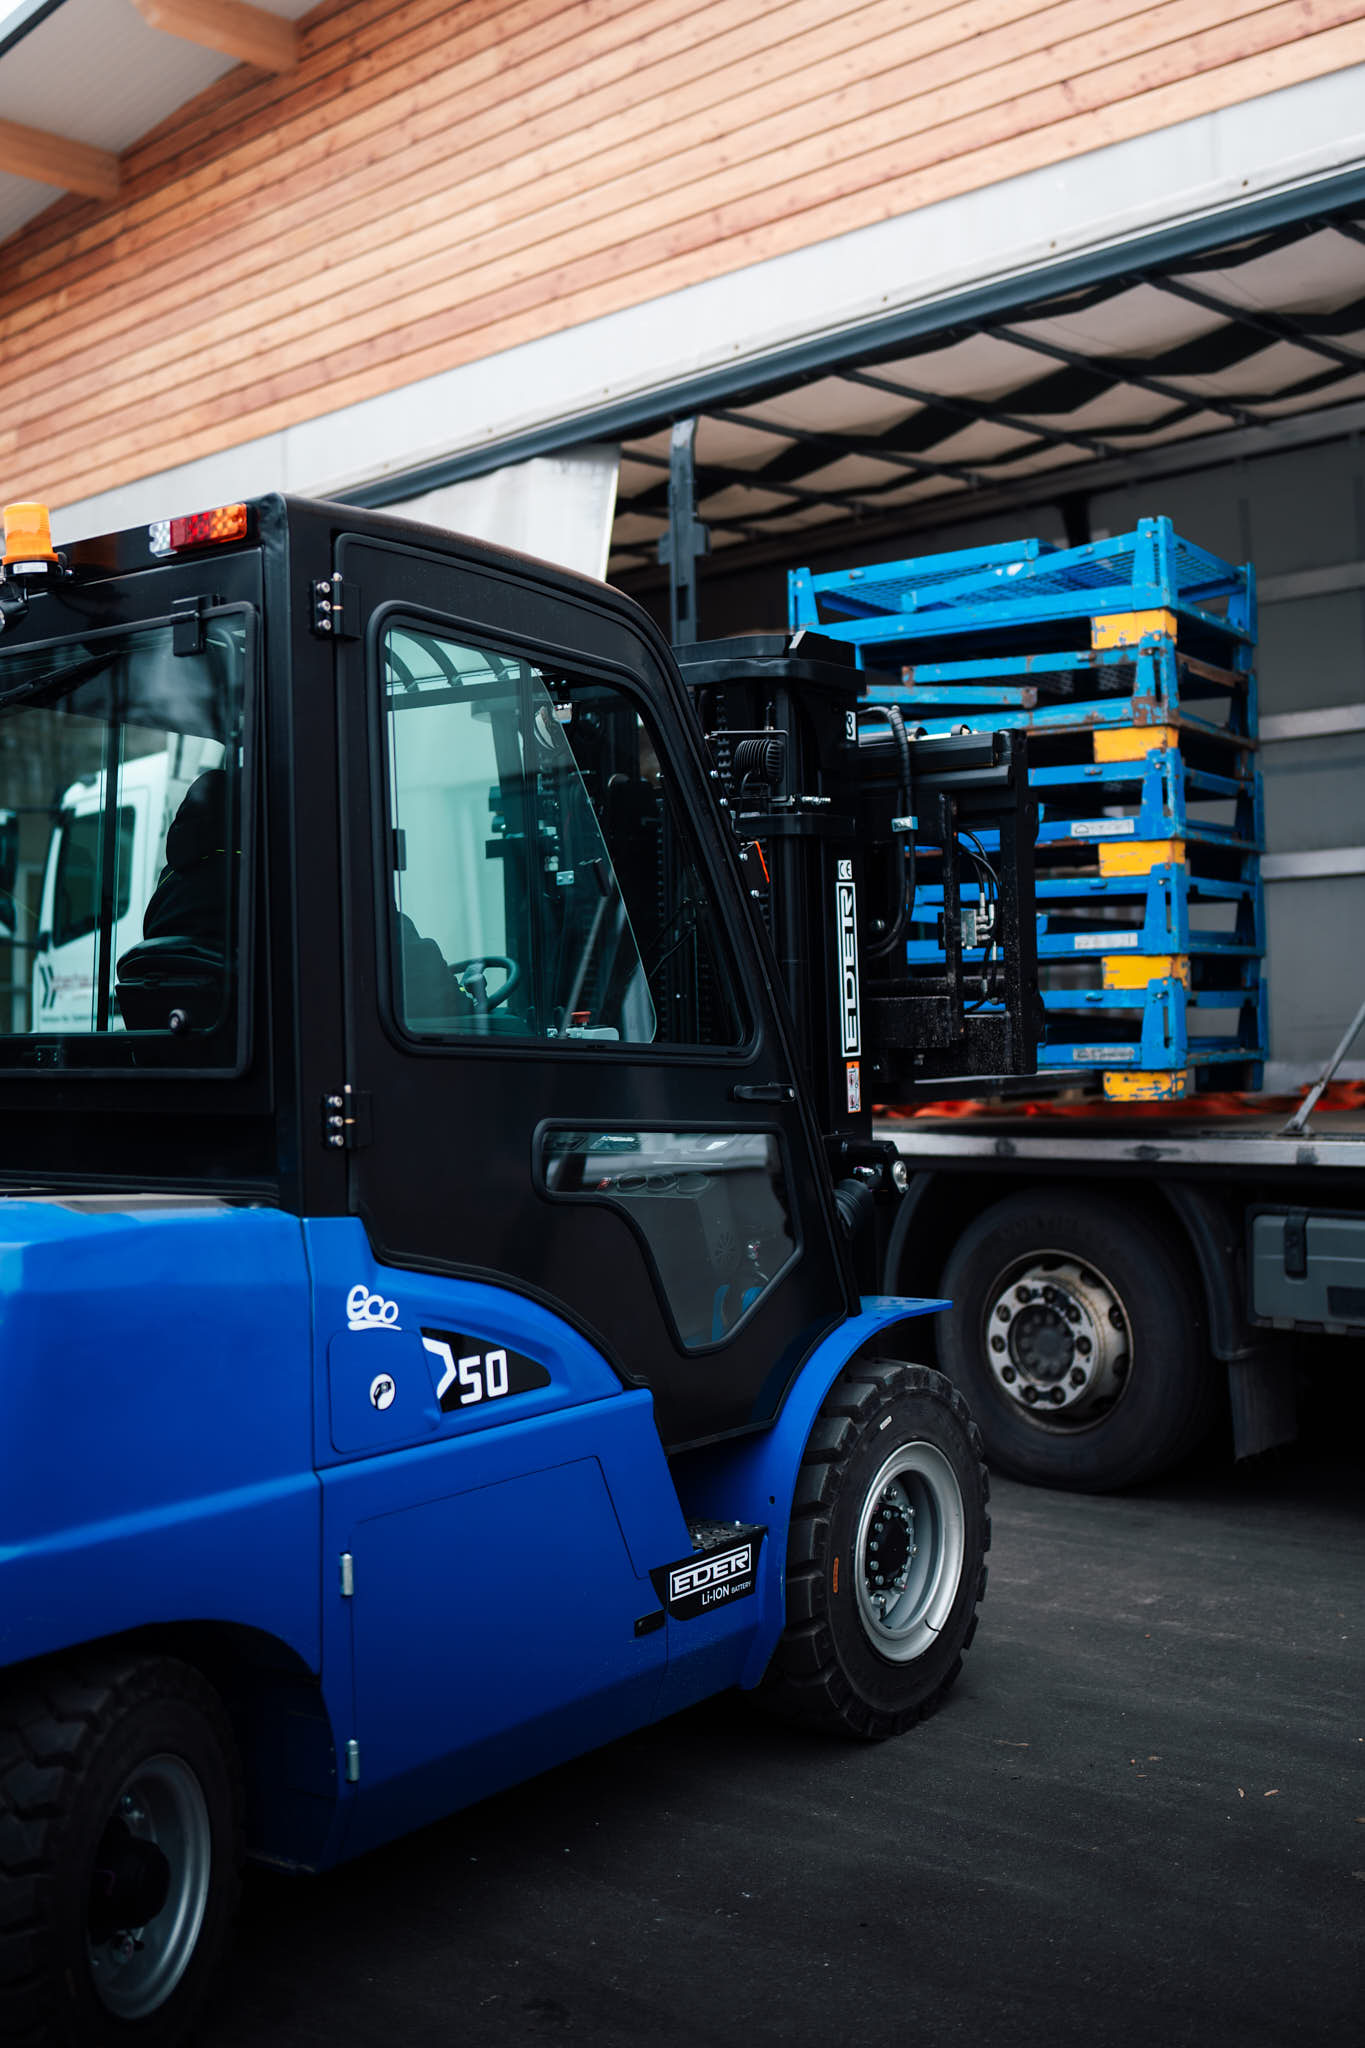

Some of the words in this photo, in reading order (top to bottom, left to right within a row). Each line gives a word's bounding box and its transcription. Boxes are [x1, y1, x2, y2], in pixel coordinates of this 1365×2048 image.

[839, 888, 858, 1050] EDER
[458, 1349, 508, 1405] 50
[673, 1551, 749, 1594] EDER
[702, 1584, 730, 1605] Li-ION
[731, 1581, 752, 1593] BATTERY
